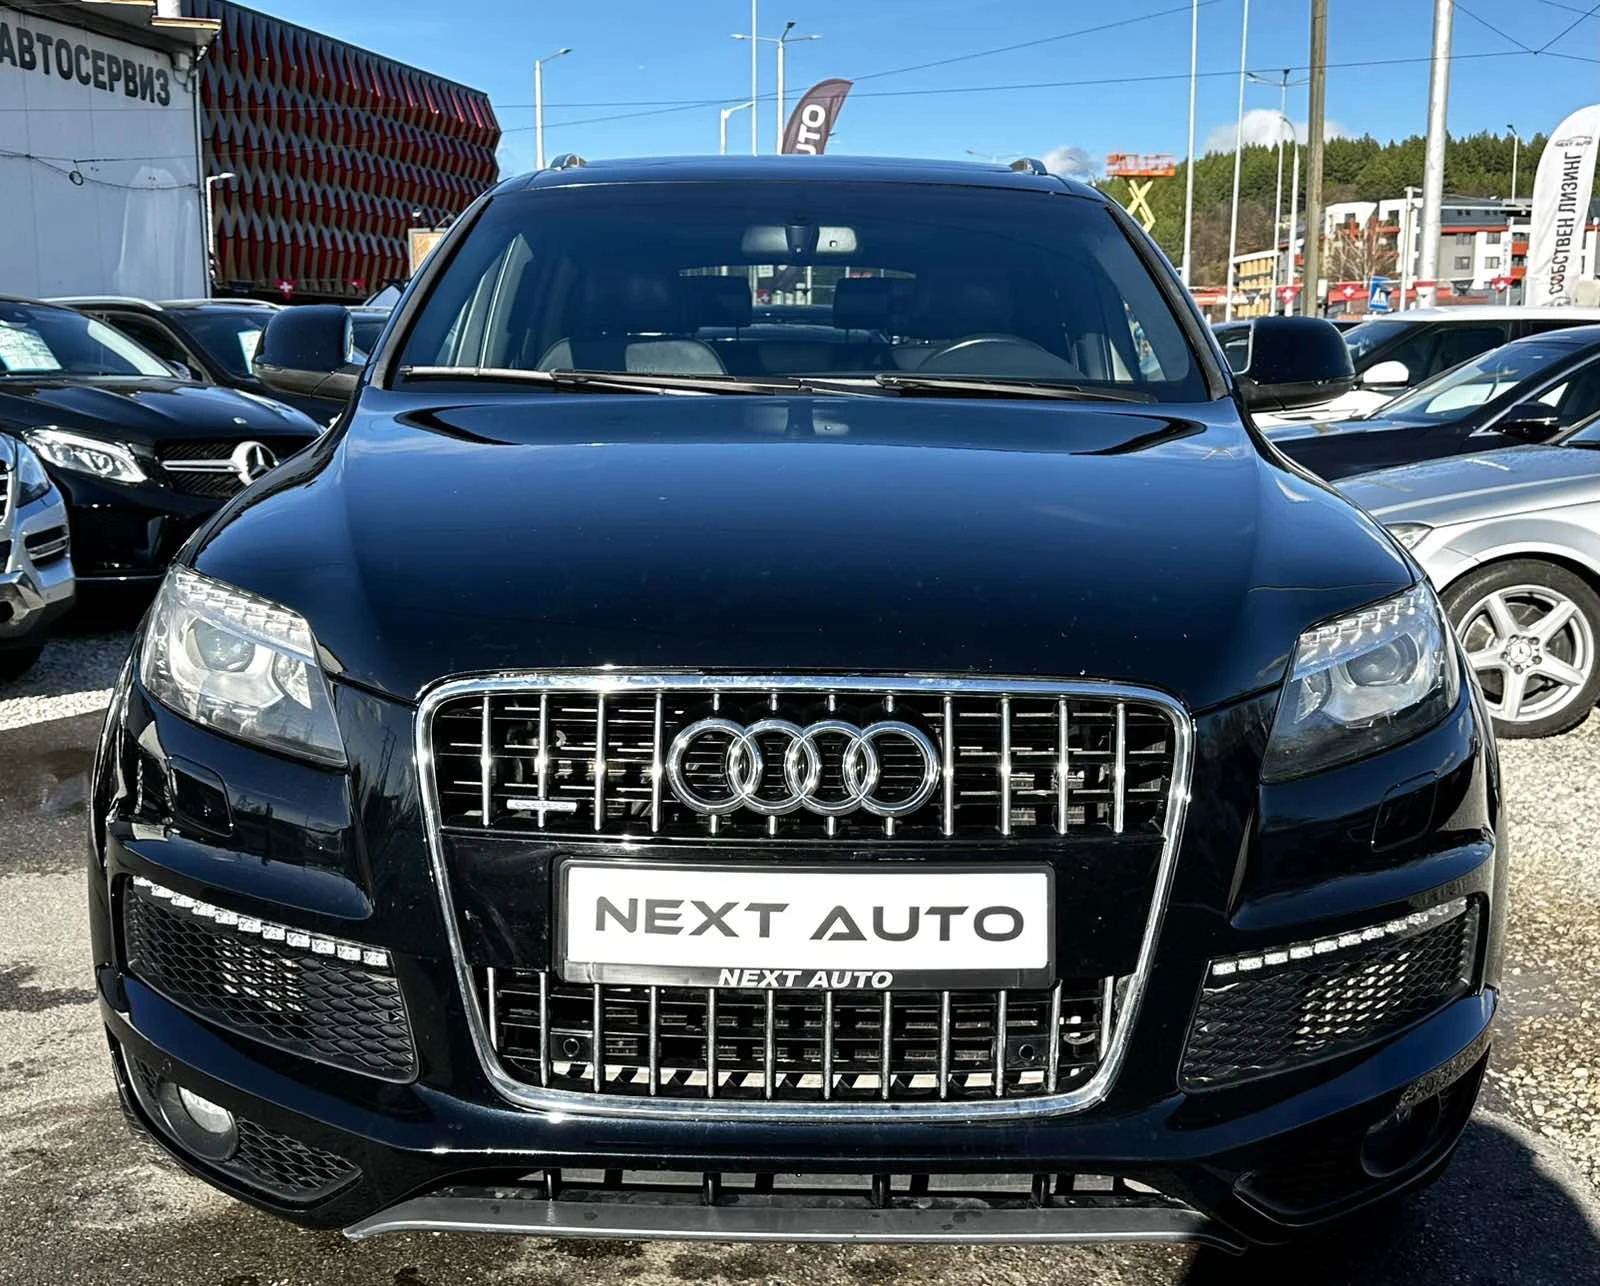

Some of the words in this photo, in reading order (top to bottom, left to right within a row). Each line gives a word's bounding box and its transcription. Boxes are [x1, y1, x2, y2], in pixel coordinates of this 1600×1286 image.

[0, 22, 170, 106] АВТОСЕРВИЗ
[1558, 152, 1582, 213] ЛИЗИНГ
[1549, 218, 1575, 295] СОБСТВЕН
[596, 896, 790, 938] NEXT
[809, 905, 1024, 941] AUTO
[718, 968, 802, 987] NEXT
[807, 971, 893, 989] AUTO
